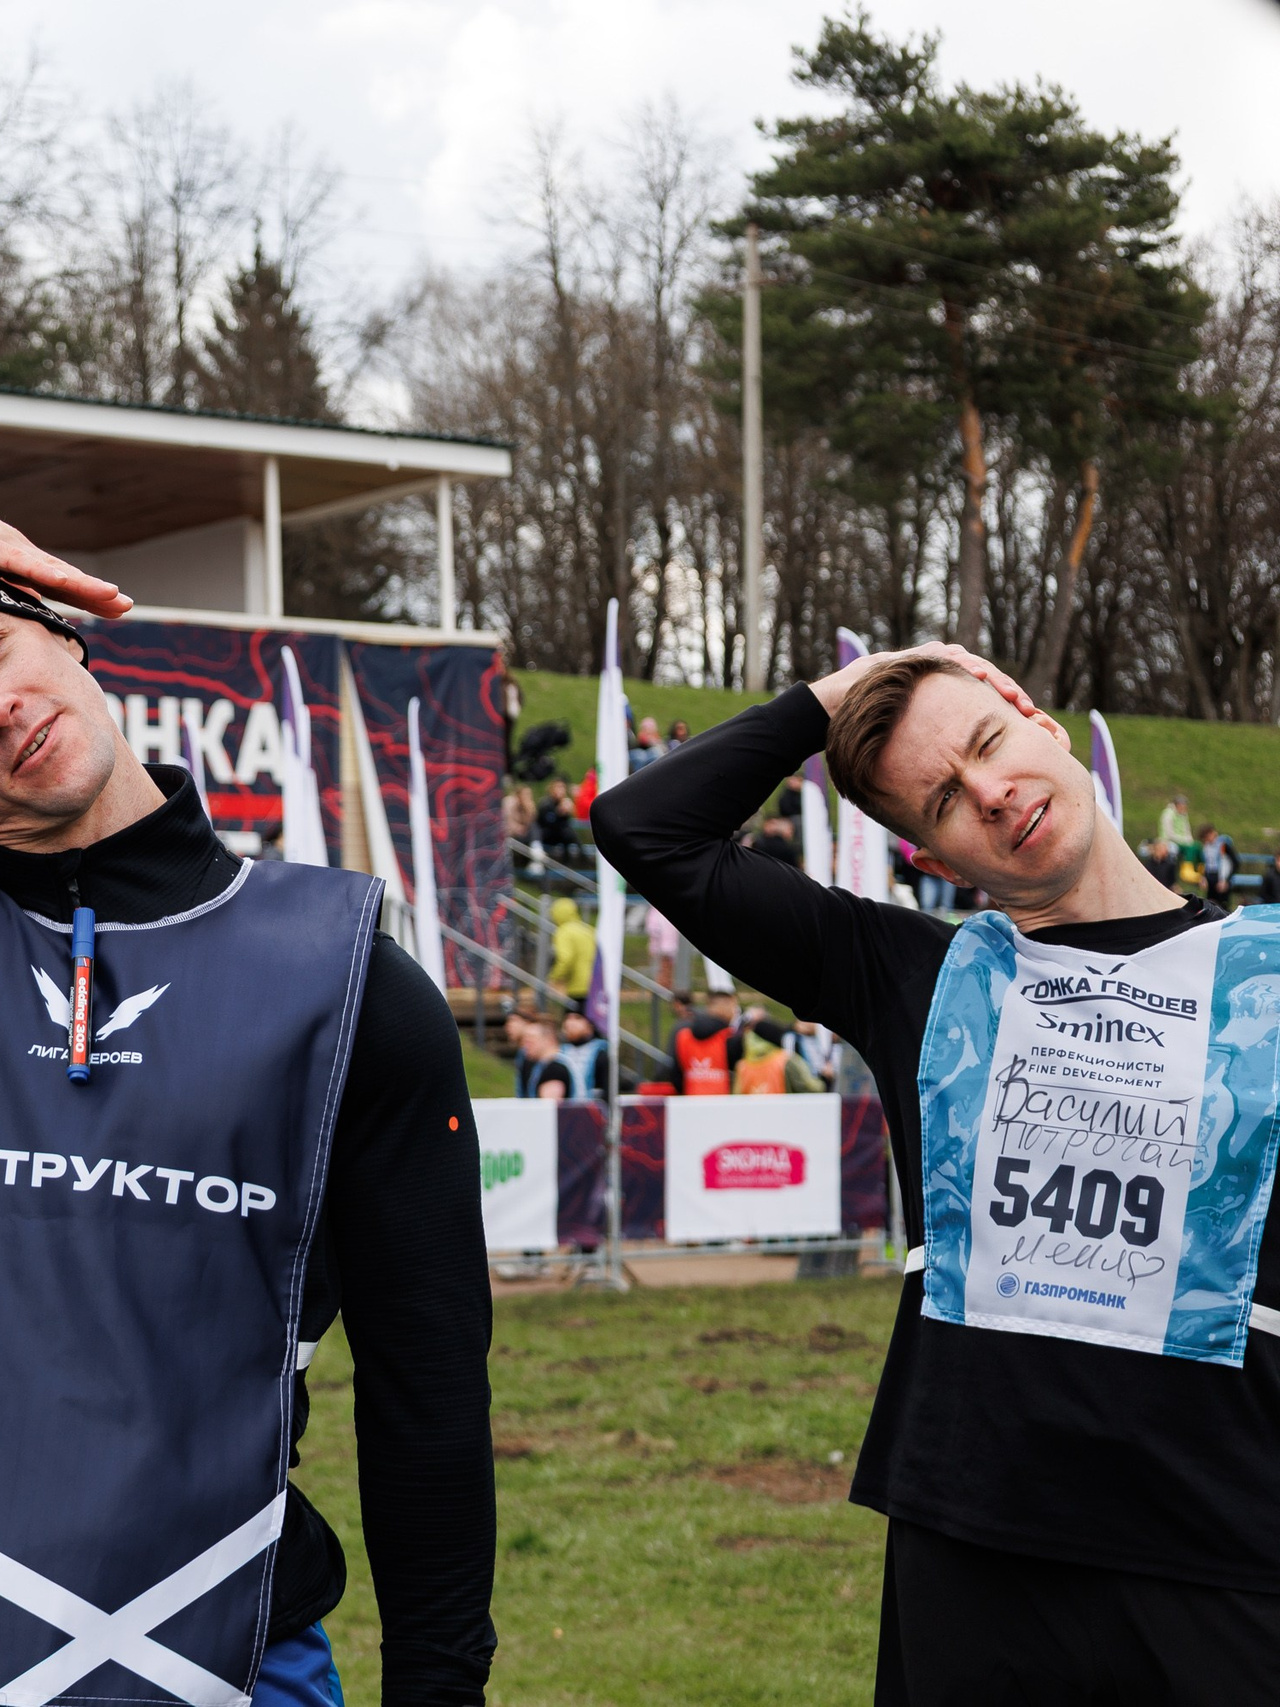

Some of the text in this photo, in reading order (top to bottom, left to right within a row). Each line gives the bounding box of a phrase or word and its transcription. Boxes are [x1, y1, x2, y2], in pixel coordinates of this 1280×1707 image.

[105, 692, 284, 785] НКА
[1020, 976, 1198, 1015] ГОНКА ГЕРОЕВ
[75, 976, 88, 1053] edding 300
[1035, 1011, 1166, 1048] Sminex
[90, 1051, 143, 1065] ЕРОЕВ
[1028, 1063, 1163, 1089] FINE DEVELOPMENT
[1030, 1046, 1165, 1073] ПЕРФЕКЦИОНИСТЫ
[989, 1156, 1165, 1247] 5409
[1024, 1280, 1127, 1310] ГАЗПРОМБАНК
